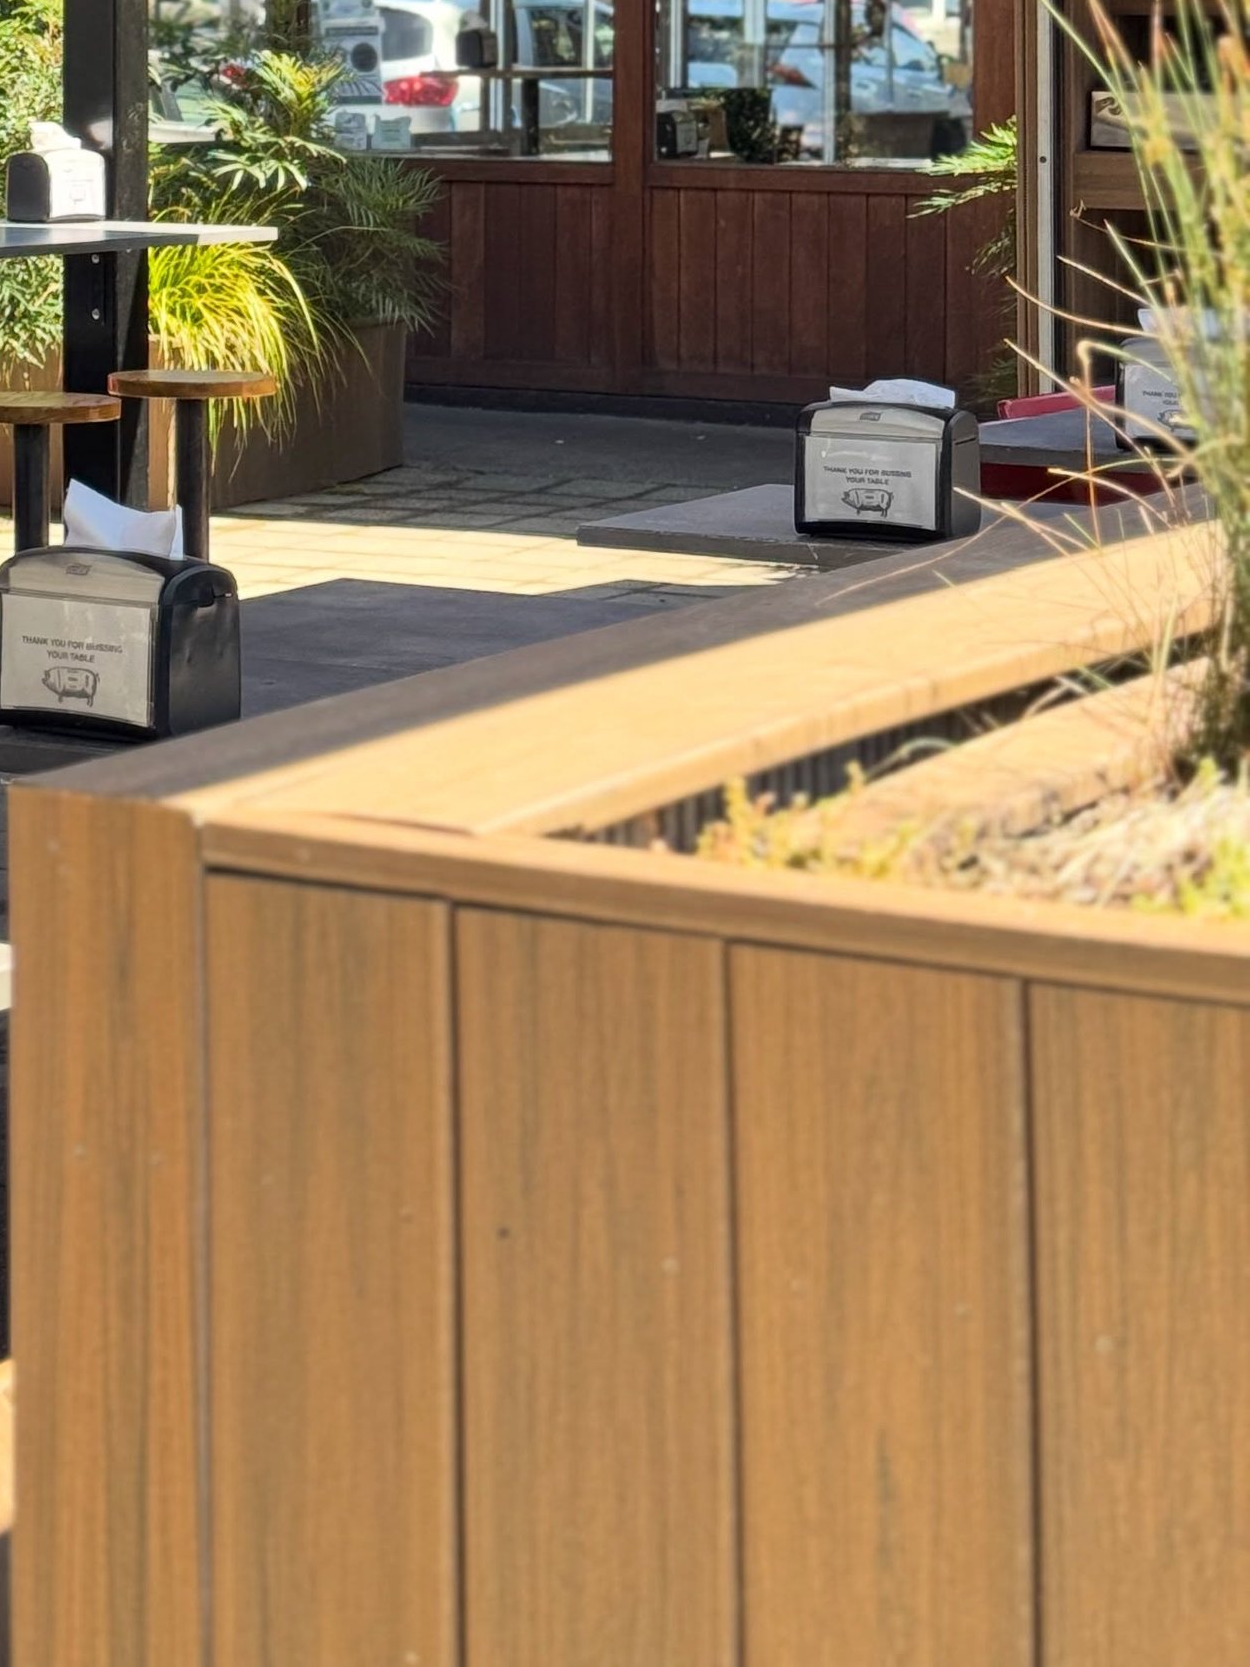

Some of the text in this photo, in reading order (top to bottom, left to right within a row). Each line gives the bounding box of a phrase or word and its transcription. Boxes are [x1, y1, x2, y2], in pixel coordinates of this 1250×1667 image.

[823, 465, 847, 473] THANK
[845, 476, 866, 484] YOUR
[22, 635, 49, 645] THANK
[50, 638, 66, 648] YOU
[67, 640, 84, 649] FOR
[46, 649, 95, 663] YOUR TABLE
